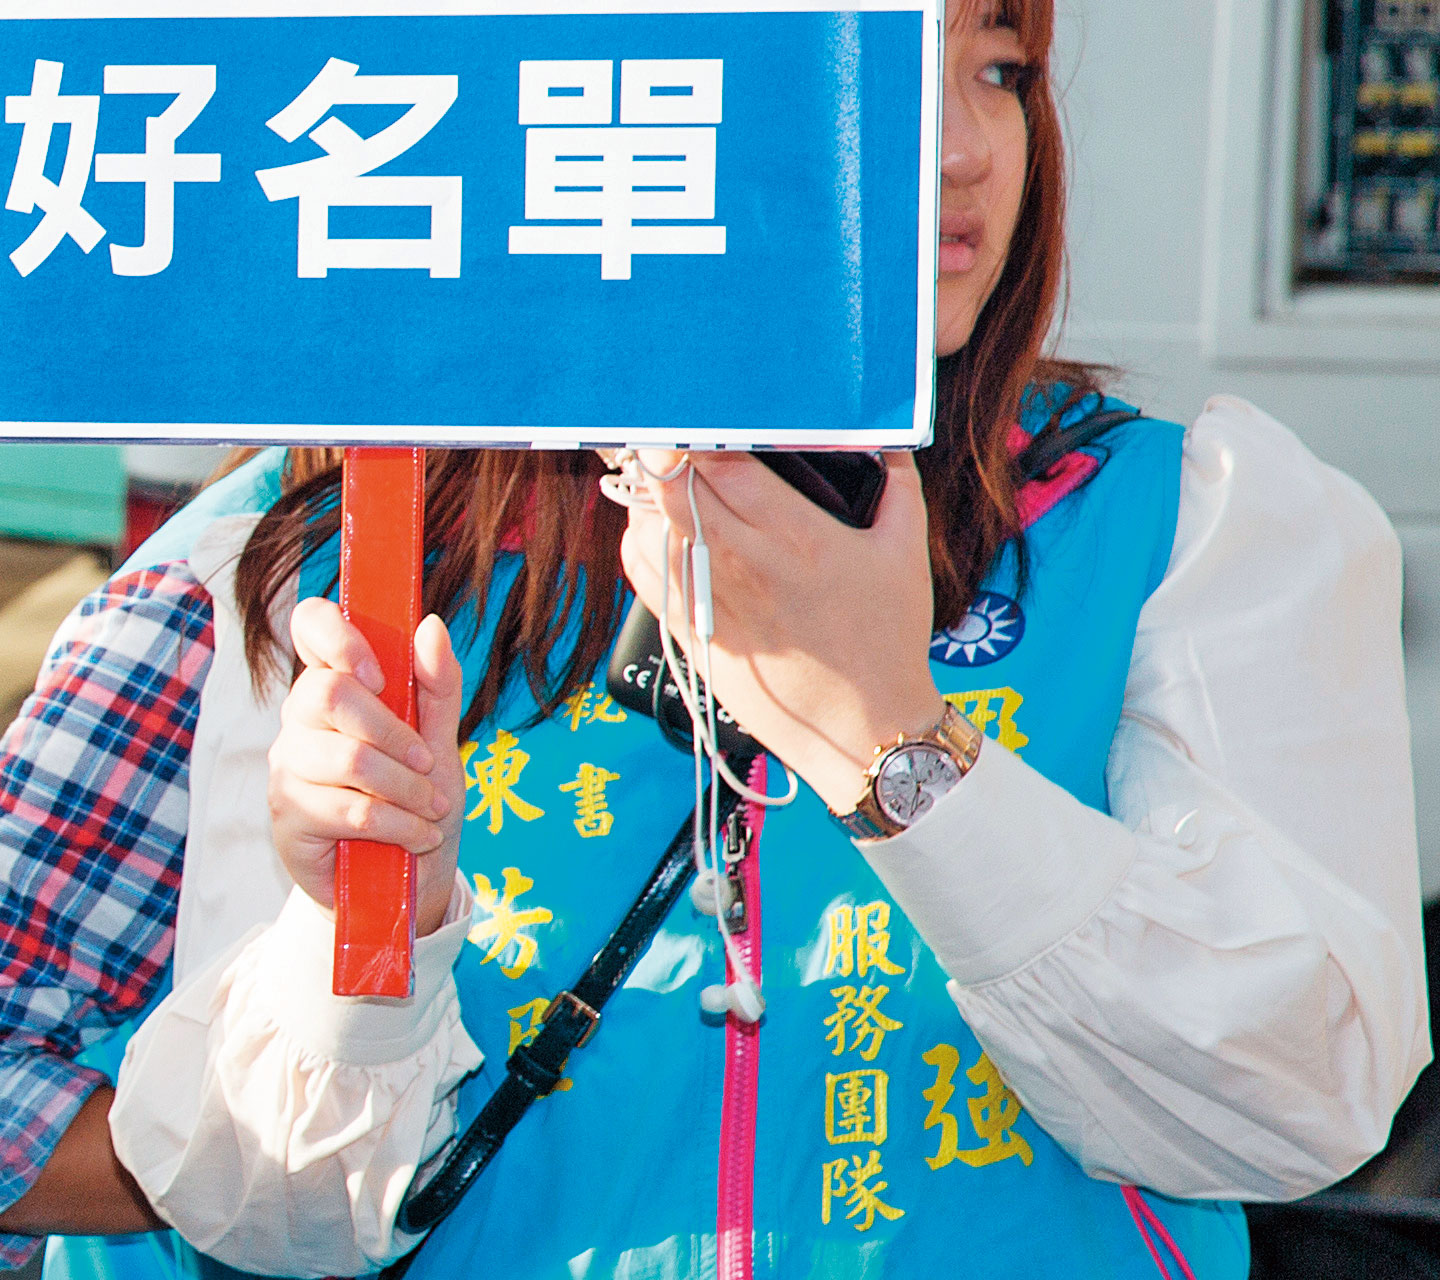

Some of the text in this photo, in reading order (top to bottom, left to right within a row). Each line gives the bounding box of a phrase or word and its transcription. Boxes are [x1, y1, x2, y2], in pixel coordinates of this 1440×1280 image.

[4, 57, 727, 281] 好名單
[821, 900, 906, 1232] 服務團隊
